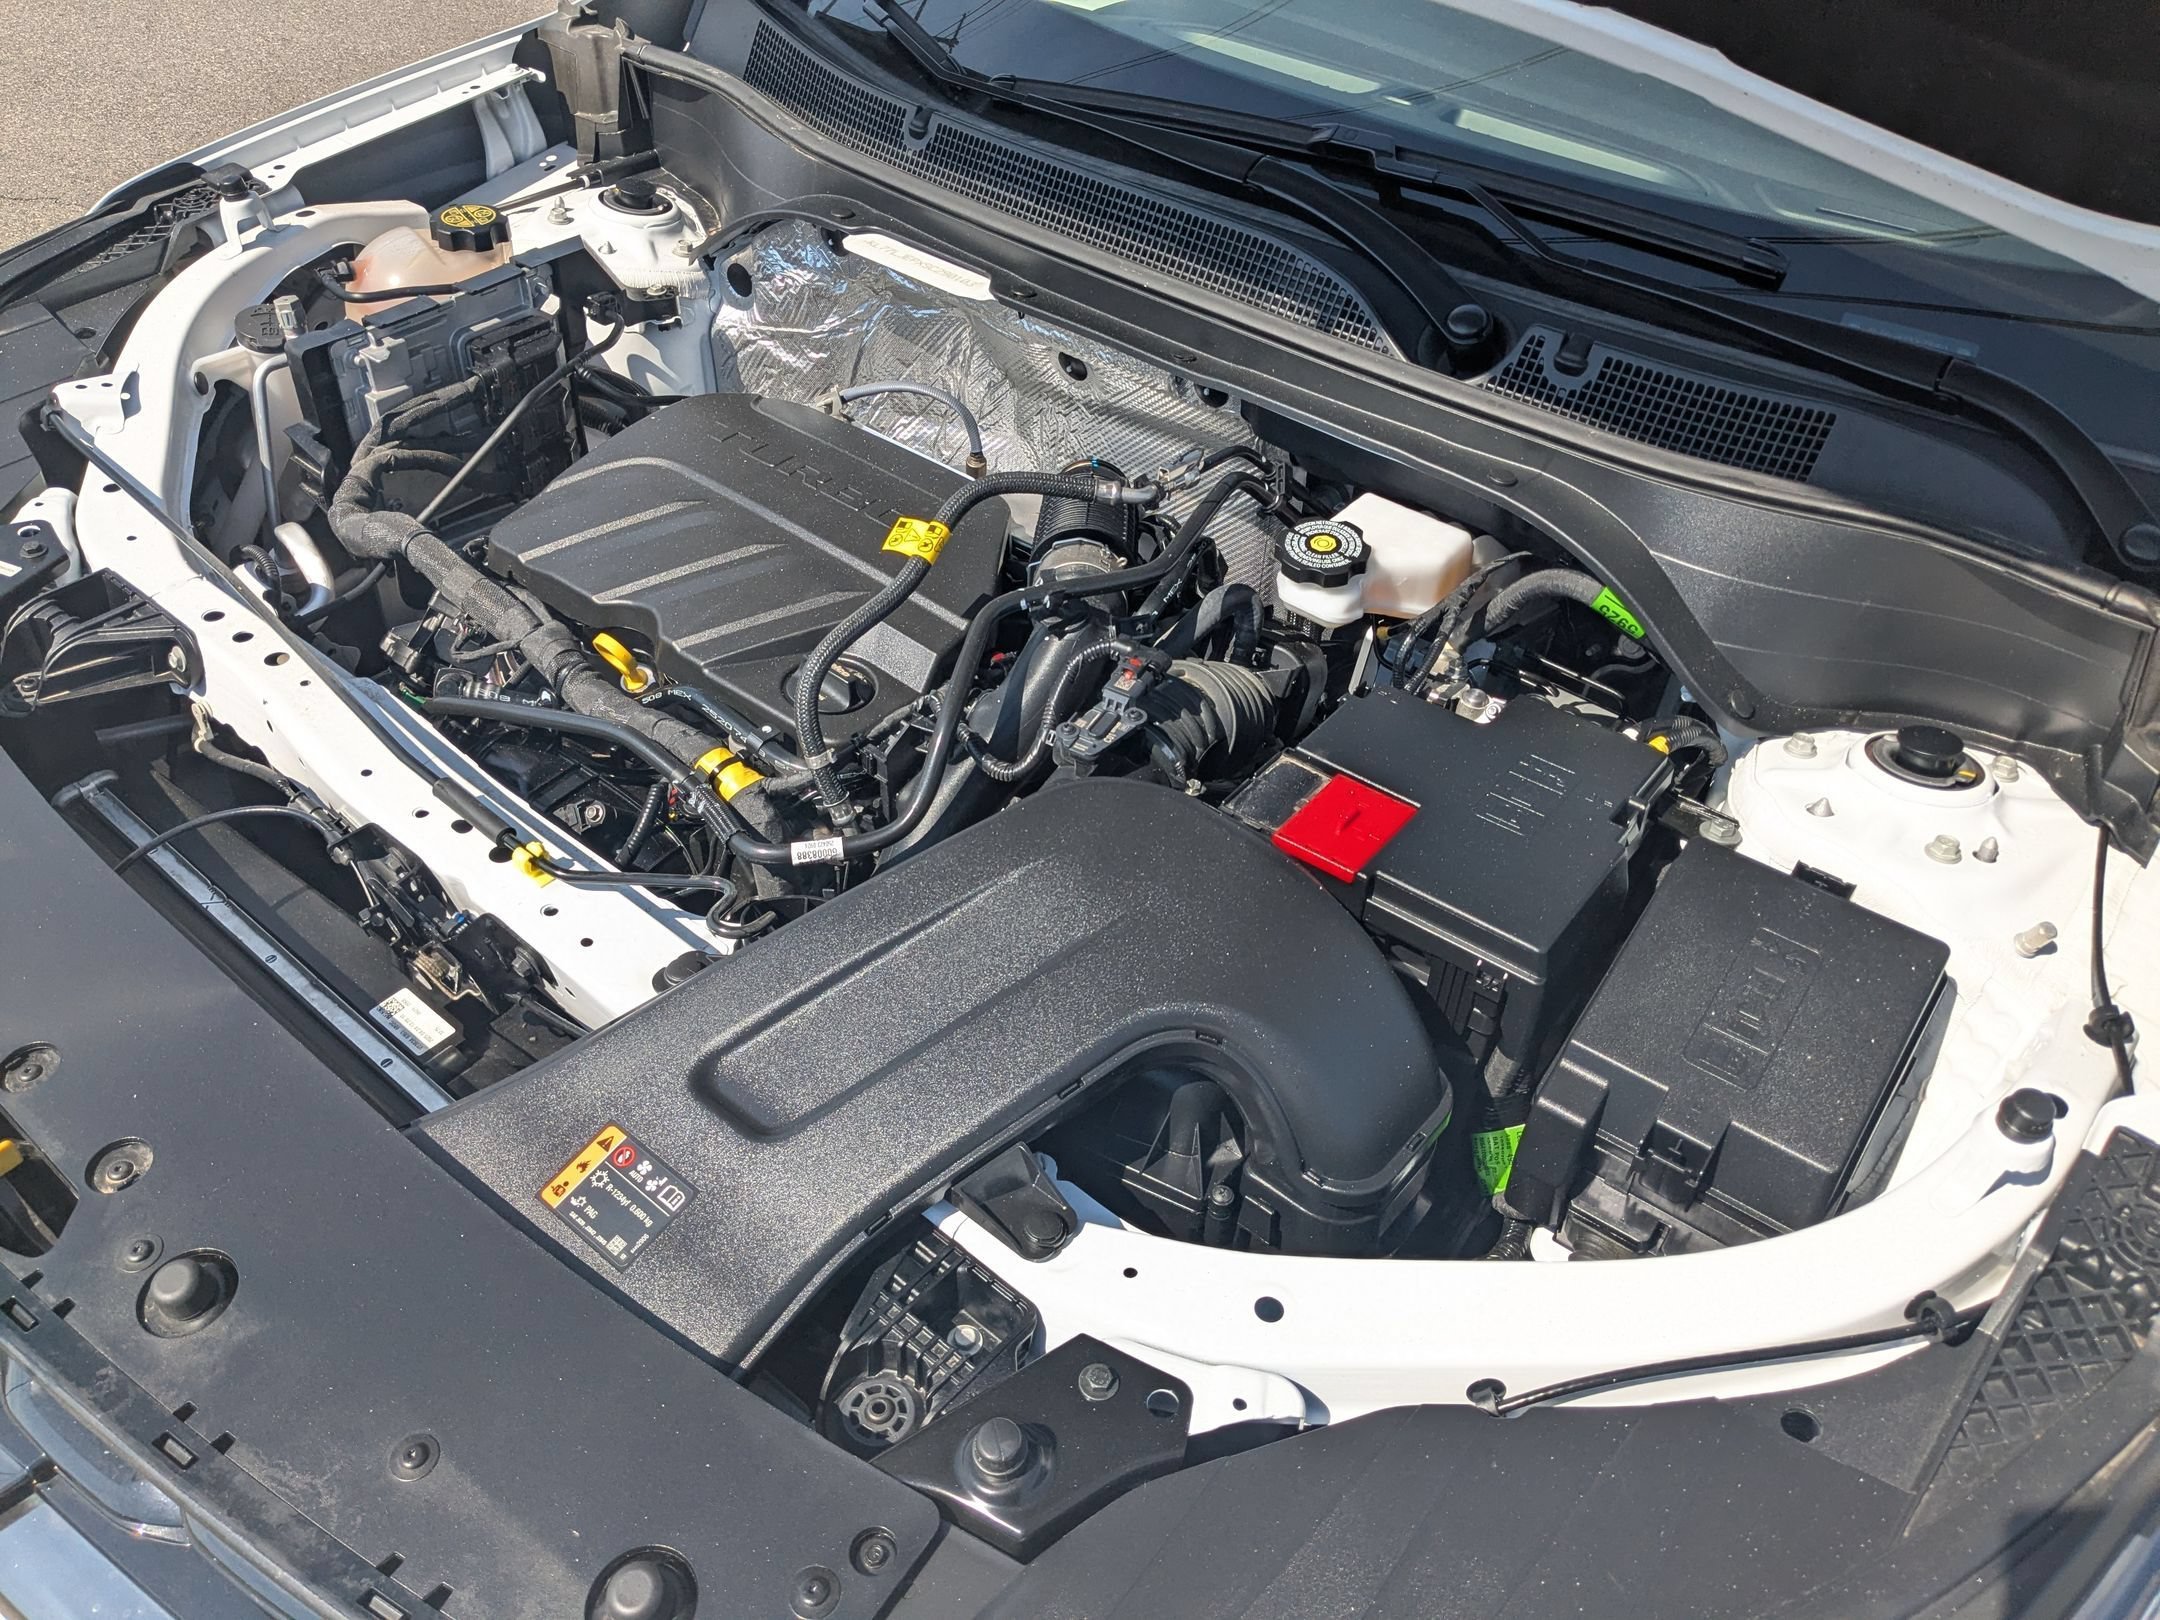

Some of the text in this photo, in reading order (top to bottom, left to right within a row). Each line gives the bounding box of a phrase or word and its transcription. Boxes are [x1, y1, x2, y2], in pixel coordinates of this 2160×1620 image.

[641, 689, 692, 705] 508 MEX
[701, 703, 748, 744] 252074
[628, 1169, 644, 1183] AUTO
[583, 1204, 600, 1220] PAG
[605, 1183, 632, 1208] R-1234yf
[642, 1217, 654, 1228] kg
